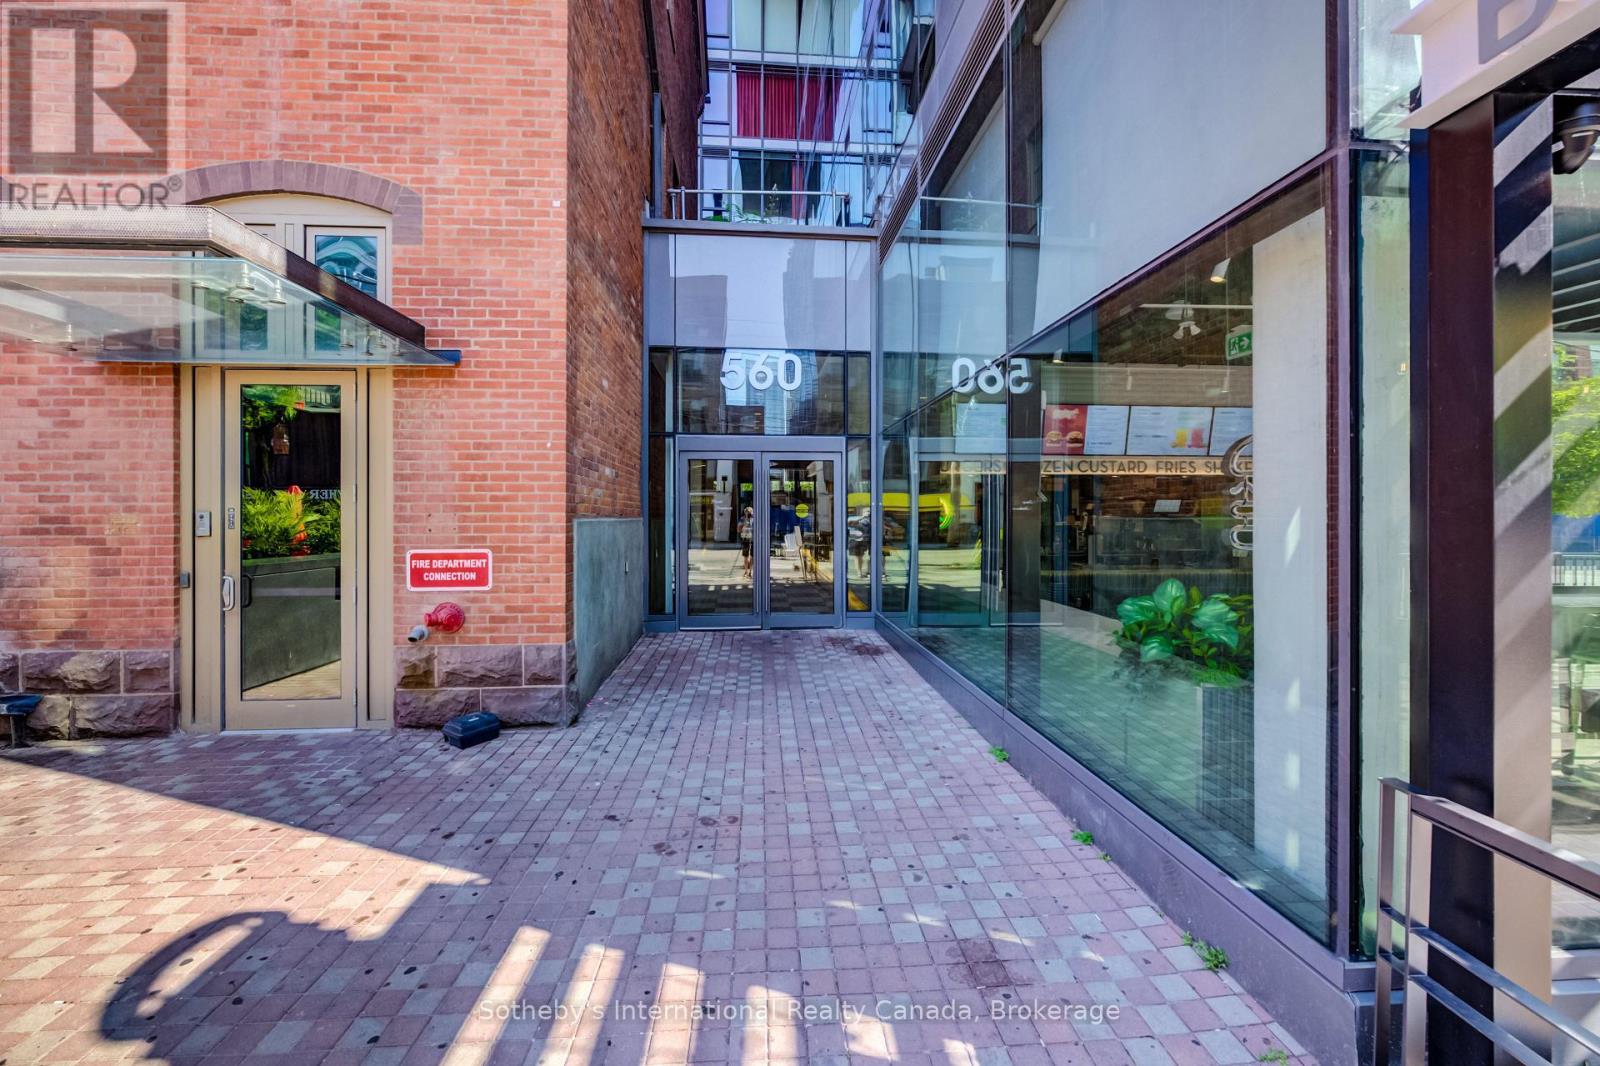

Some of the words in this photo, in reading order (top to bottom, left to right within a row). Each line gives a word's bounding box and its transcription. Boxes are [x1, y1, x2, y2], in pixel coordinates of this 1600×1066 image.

[720, 352, 802, 391] 560
[1042, 459, 1074, 473] ZEN
[1077, 460, 1148, 474] CUSTARD
[1156, 460, 1197, 474] FRIES
[411, 559, 431, 569] FIRE
[432, 559, 487, 569] DEPARTMENT
[423, 571, 477, 581] CONNECTION
